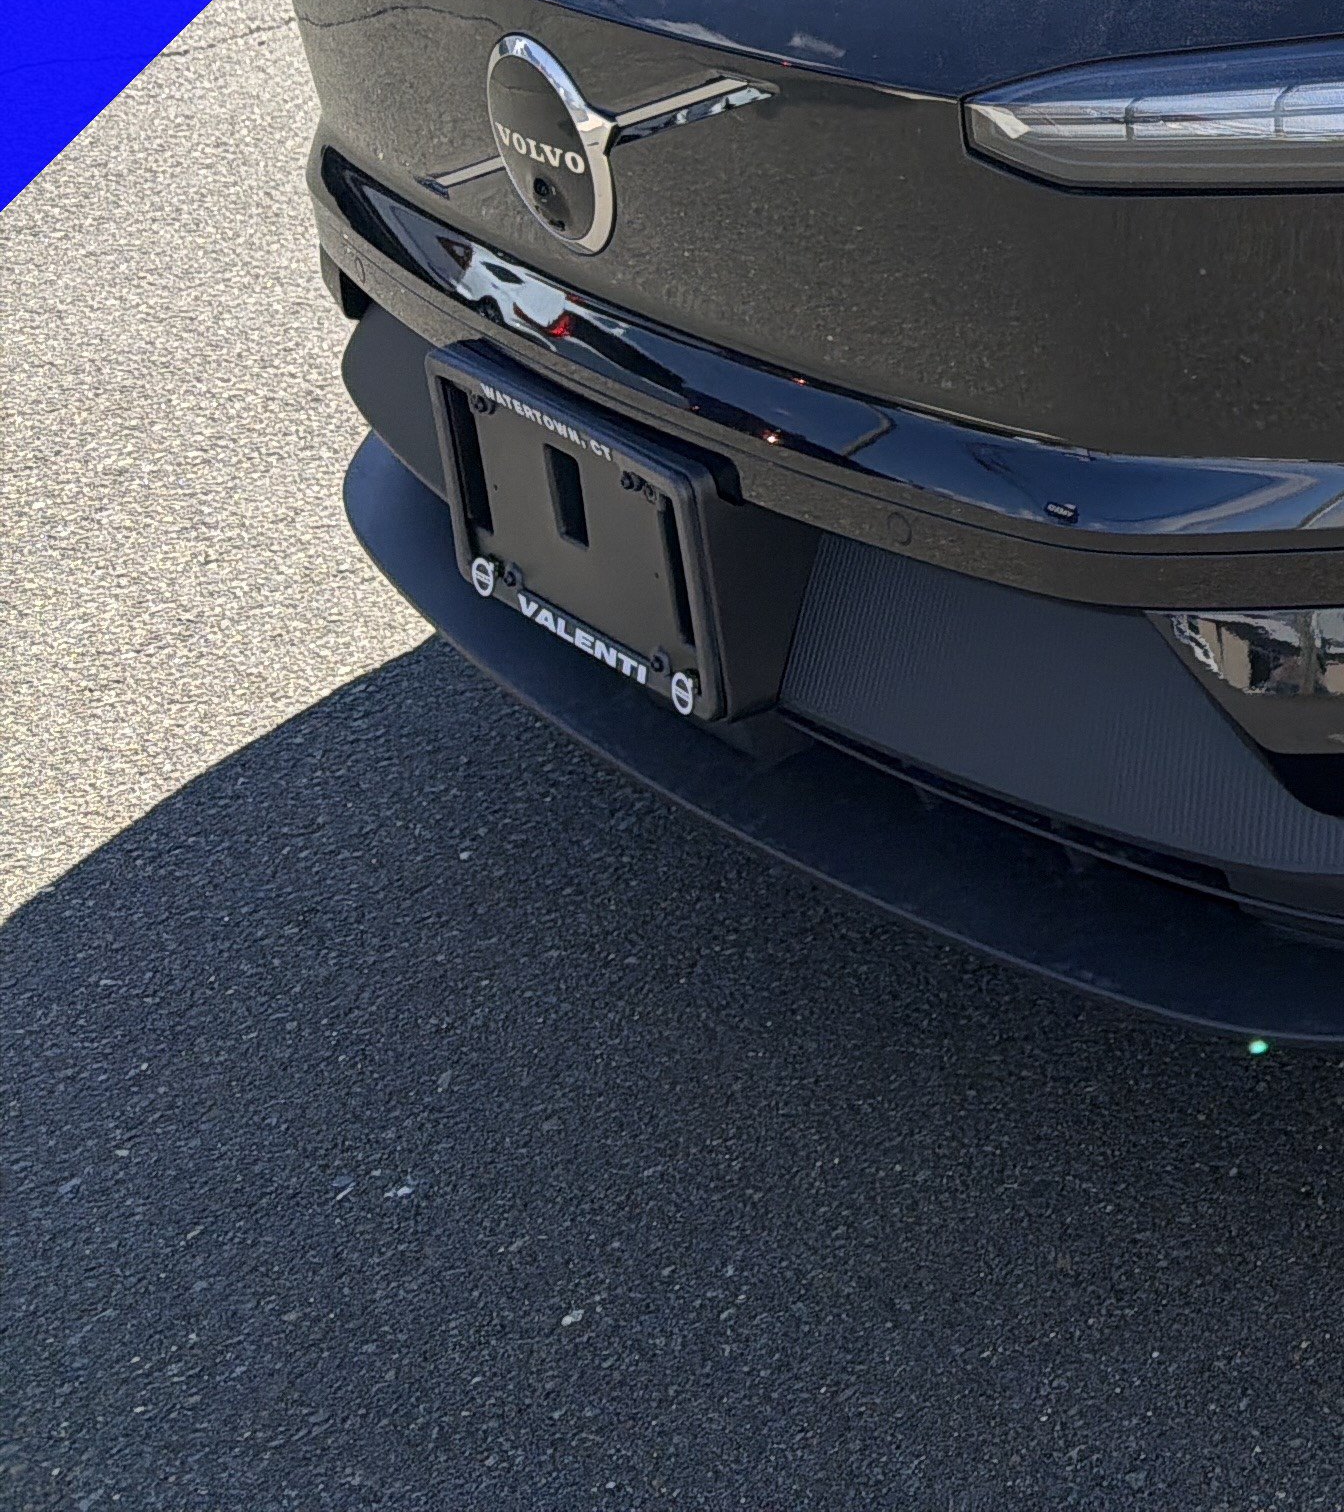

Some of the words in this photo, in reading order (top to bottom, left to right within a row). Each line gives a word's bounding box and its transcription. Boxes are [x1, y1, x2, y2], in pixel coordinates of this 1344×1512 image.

[494, 121, 585, 174] VOLVO
[480, 382, 587, 449] WATERTOWN,
[590, 439, 612, 462] CT
[517, 593, 648, 685] VALENTI
